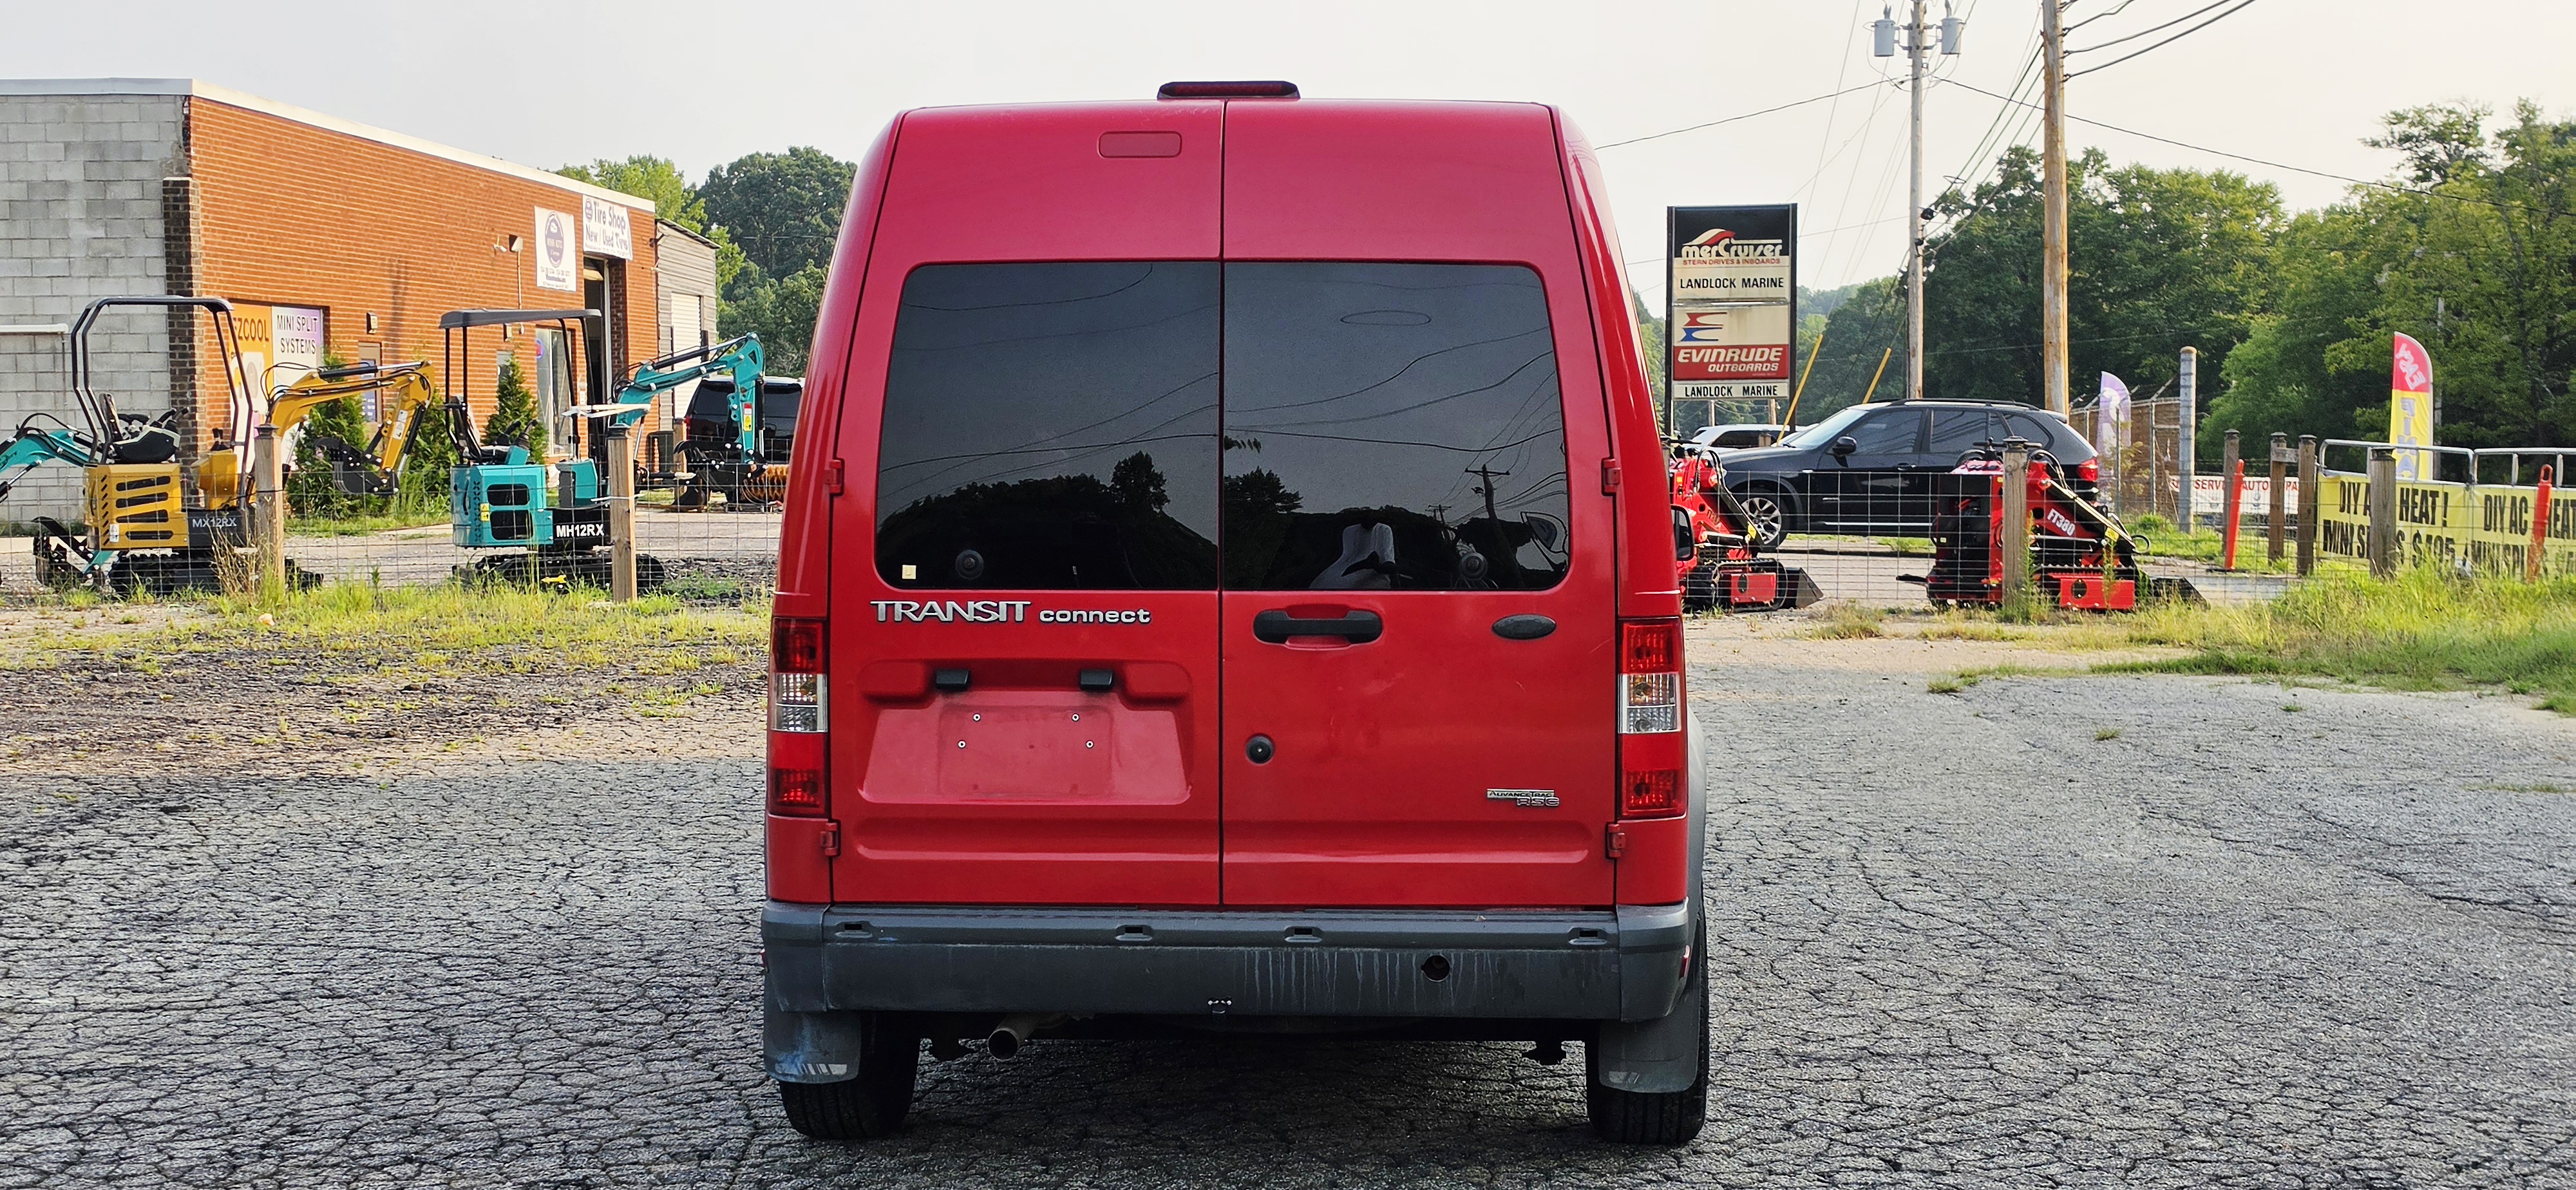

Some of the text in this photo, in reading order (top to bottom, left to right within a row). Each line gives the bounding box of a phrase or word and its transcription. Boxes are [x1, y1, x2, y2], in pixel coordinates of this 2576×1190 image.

[593, 200, 626, 235] Tire Shop
[585, 223, 598, 243] New
[602, 227, 614, 248] Used
[1680, 277, 1784, 289] LANDLOCK MARINE
[277, 314, 317, 333] MINI SPLIT
[280, 337, 316, 355] SYSTEMS
[1678, 347, 1783, 363] EVINRUDE
[1708, 363, 1779, 372] OUTBOARDS
[1685, 385, 1777, 397] LANDLOCK MARINE
[2242, 481, 2269, 491] AUTO
[2286, 481, 2298, 491] PA
[2339, 480, 2361, 515] DIY
[2399, 487, 2439, 525] HEAT
[193, 517, 237, 527] MX12RX
[2047, 508, 2076, 536] FT380
[2484, 495, 2506, 533] DIY
[2509, 495, 2528, 536] AC
[556, 524, 605, 538] MH12RX
[870, 600, 1151, 623] TRANSIT connect
[1517, 797, 1560, 806] RSC
